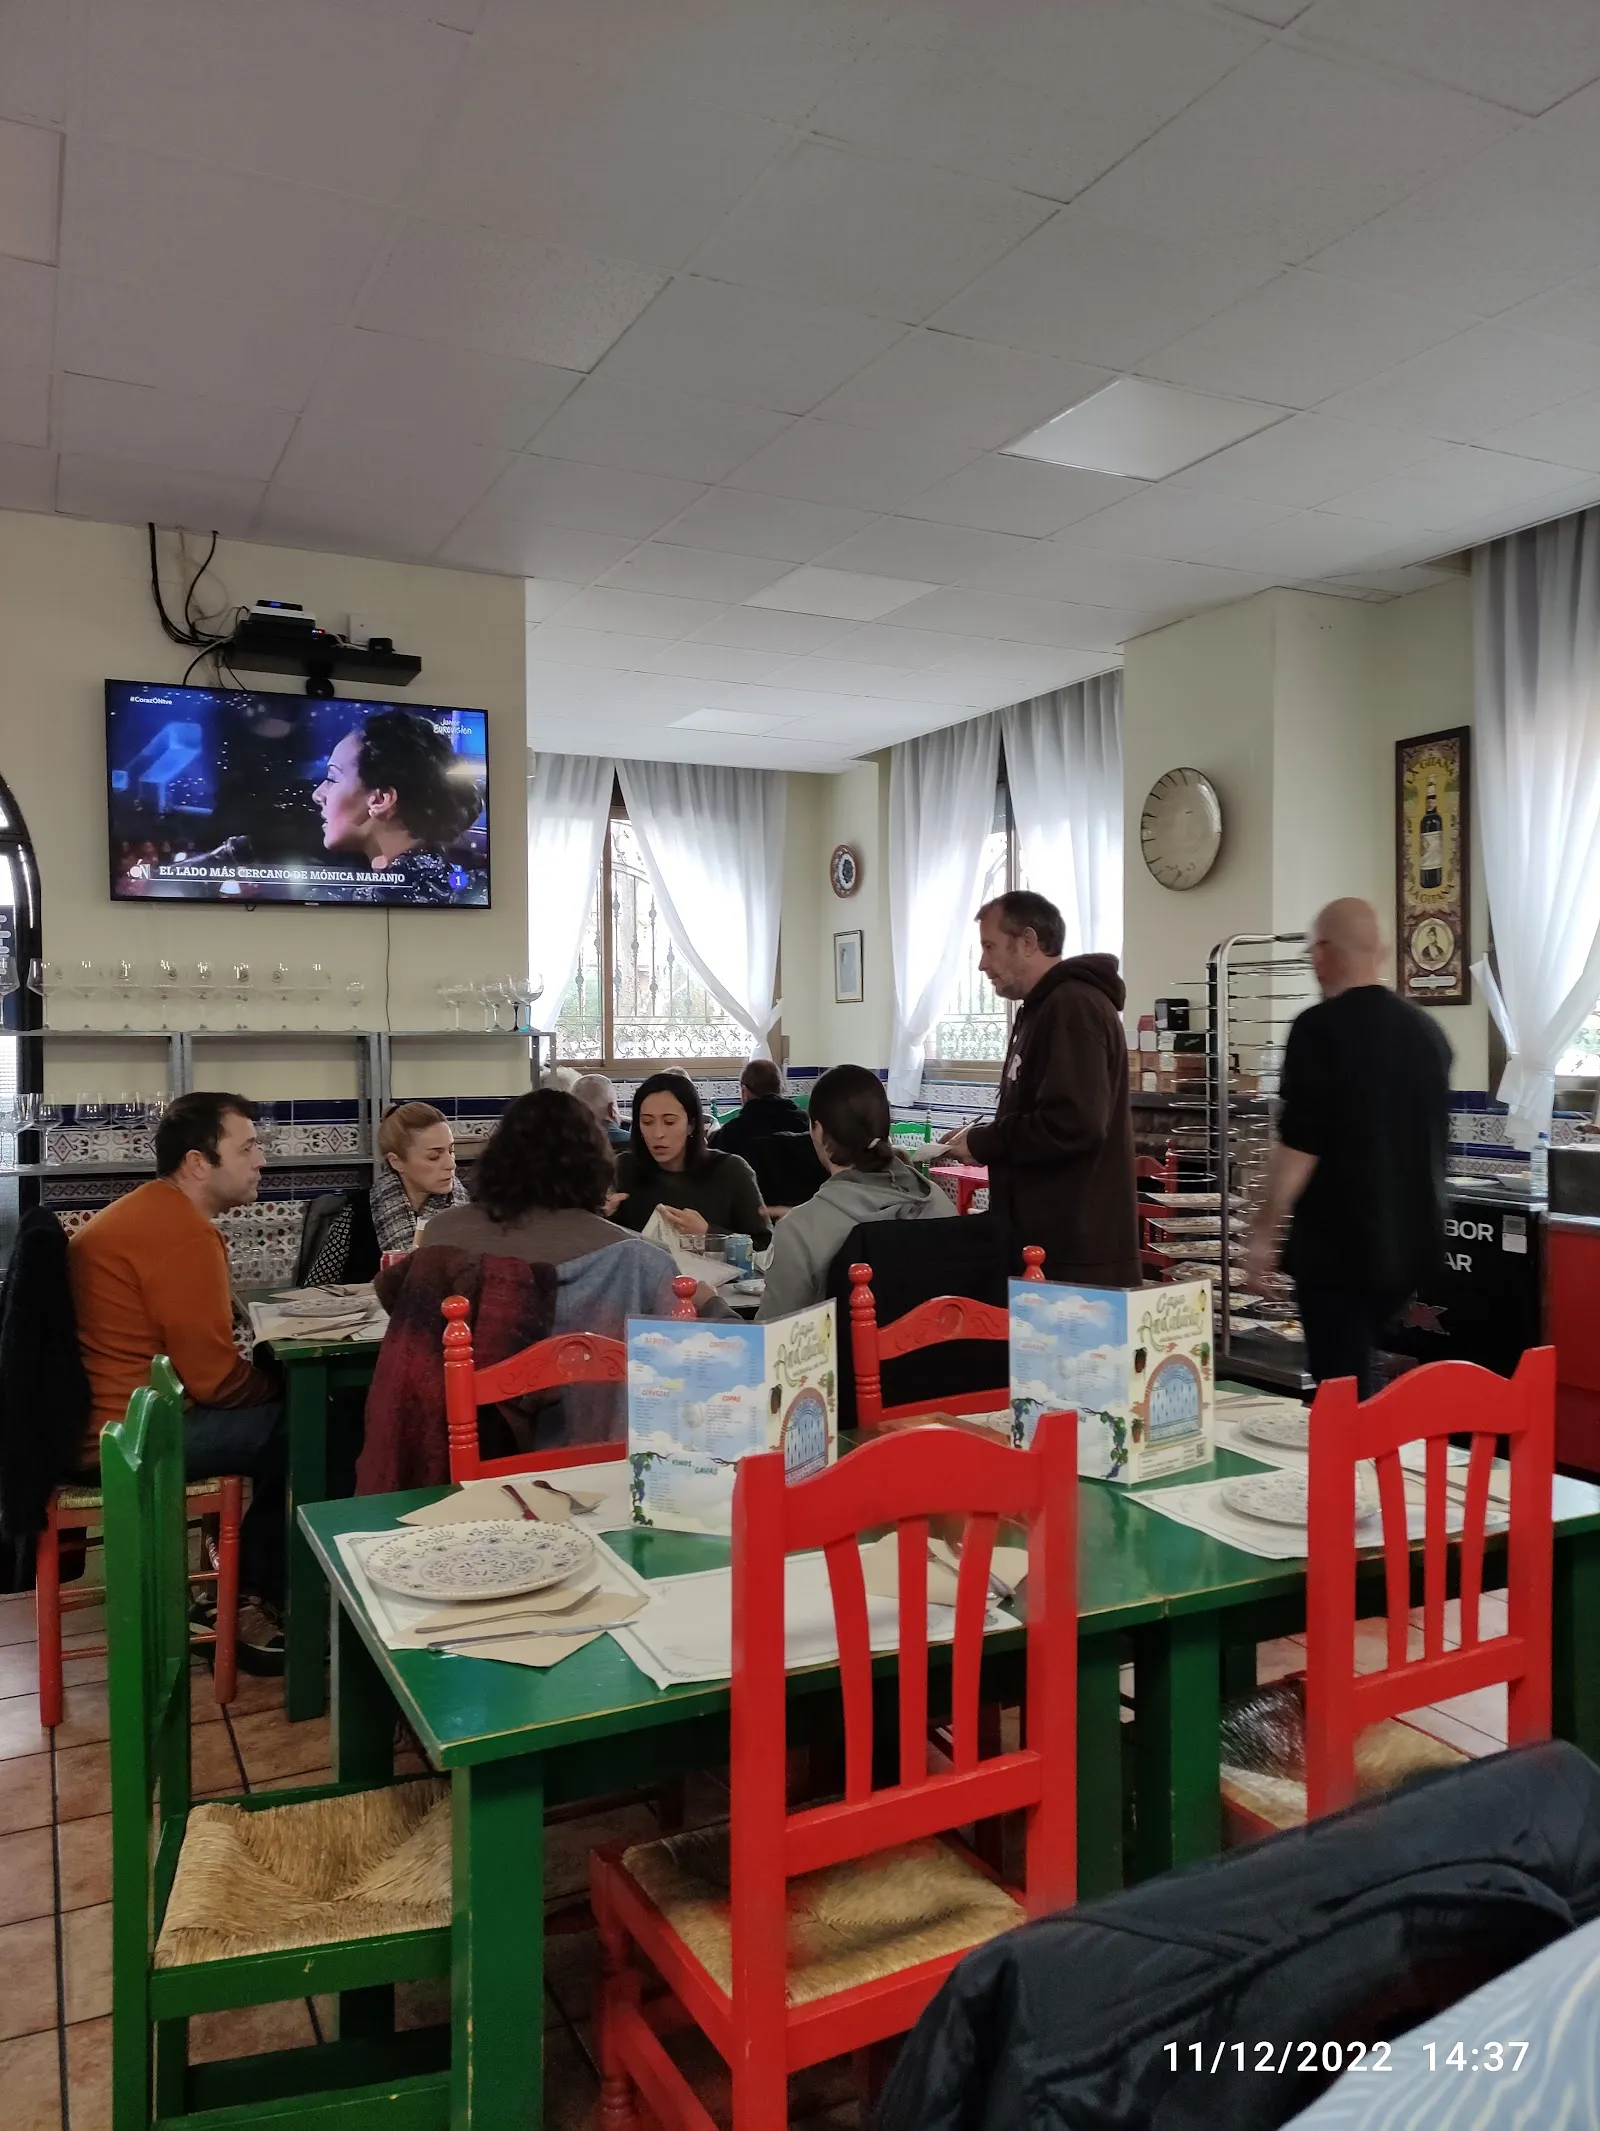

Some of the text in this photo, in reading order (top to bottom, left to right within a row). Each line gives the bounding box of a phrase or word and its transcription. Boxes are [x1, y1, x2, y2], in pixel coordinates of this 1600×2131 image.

[159, 866, 406, 884] EL LADO MÁS CERCANO DE MÓNICA NARANJO
[1444, 1218, 1494, 1242] BOR
[1444, 1251, 1473, 1273] AR
